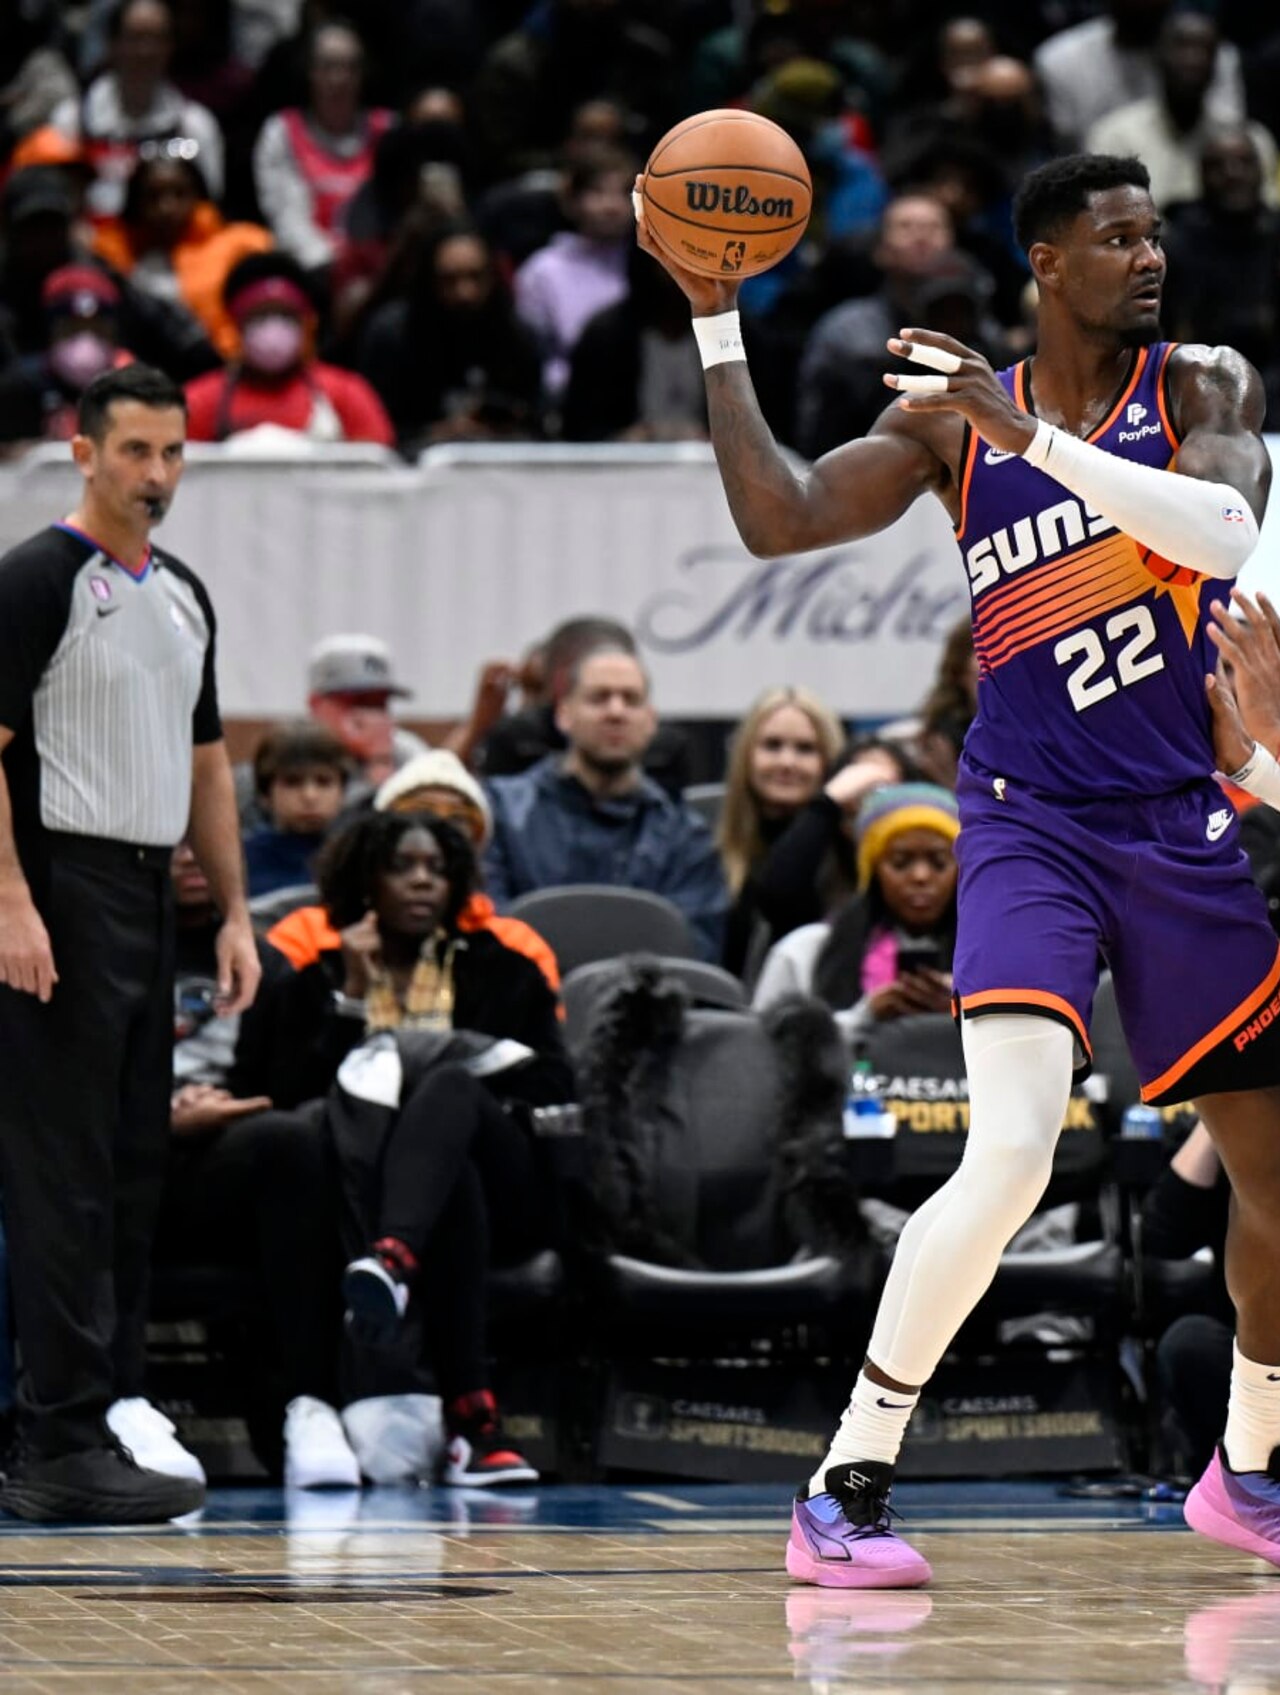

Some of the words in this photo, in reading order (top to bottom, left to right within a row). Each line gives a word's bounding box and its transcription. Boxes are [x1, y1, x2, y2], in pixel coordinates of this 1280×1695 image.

[685, 181, 793, 218] Wilson
[1118, 421, 1161, 443] PayPal
[1054, 605, 1165, 712] 22
